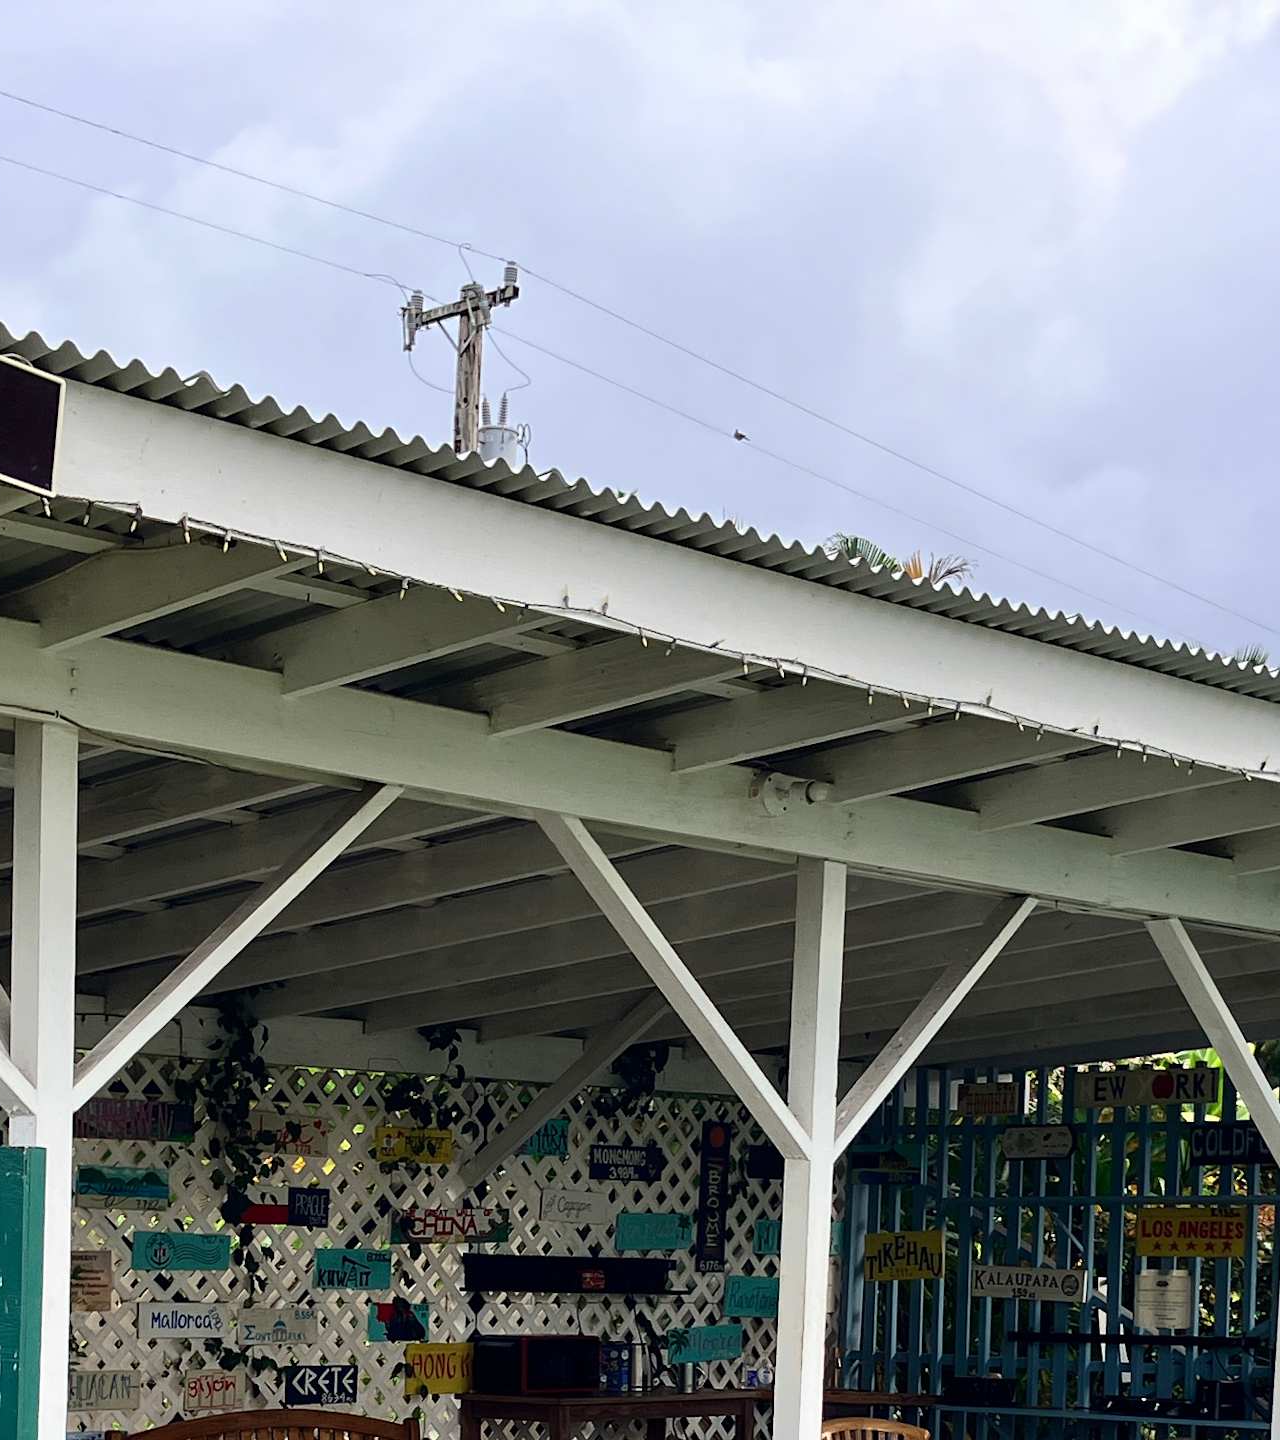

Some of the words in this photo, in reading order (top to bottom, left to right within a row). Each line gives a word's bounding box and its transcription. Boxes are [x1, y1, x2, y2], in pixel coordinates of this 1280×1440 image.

[409, 1216, 478, 1236] CHINA
[1141, 1219, 1173, 1238] LOS
[1177, 1220, 1244, 1240] ANGELES
[866, 1235, 943, 1279] TIKEHAU
[318, 1267, 372, 1287] KUWAIT
[974, 1269, 1059, 1290] KALAUPAPA
[151, 1310, 213, 1329] Mallorca
[411, 1352, 457, 1380] HONG
[291, 1367, 355, 1396] CRETE
